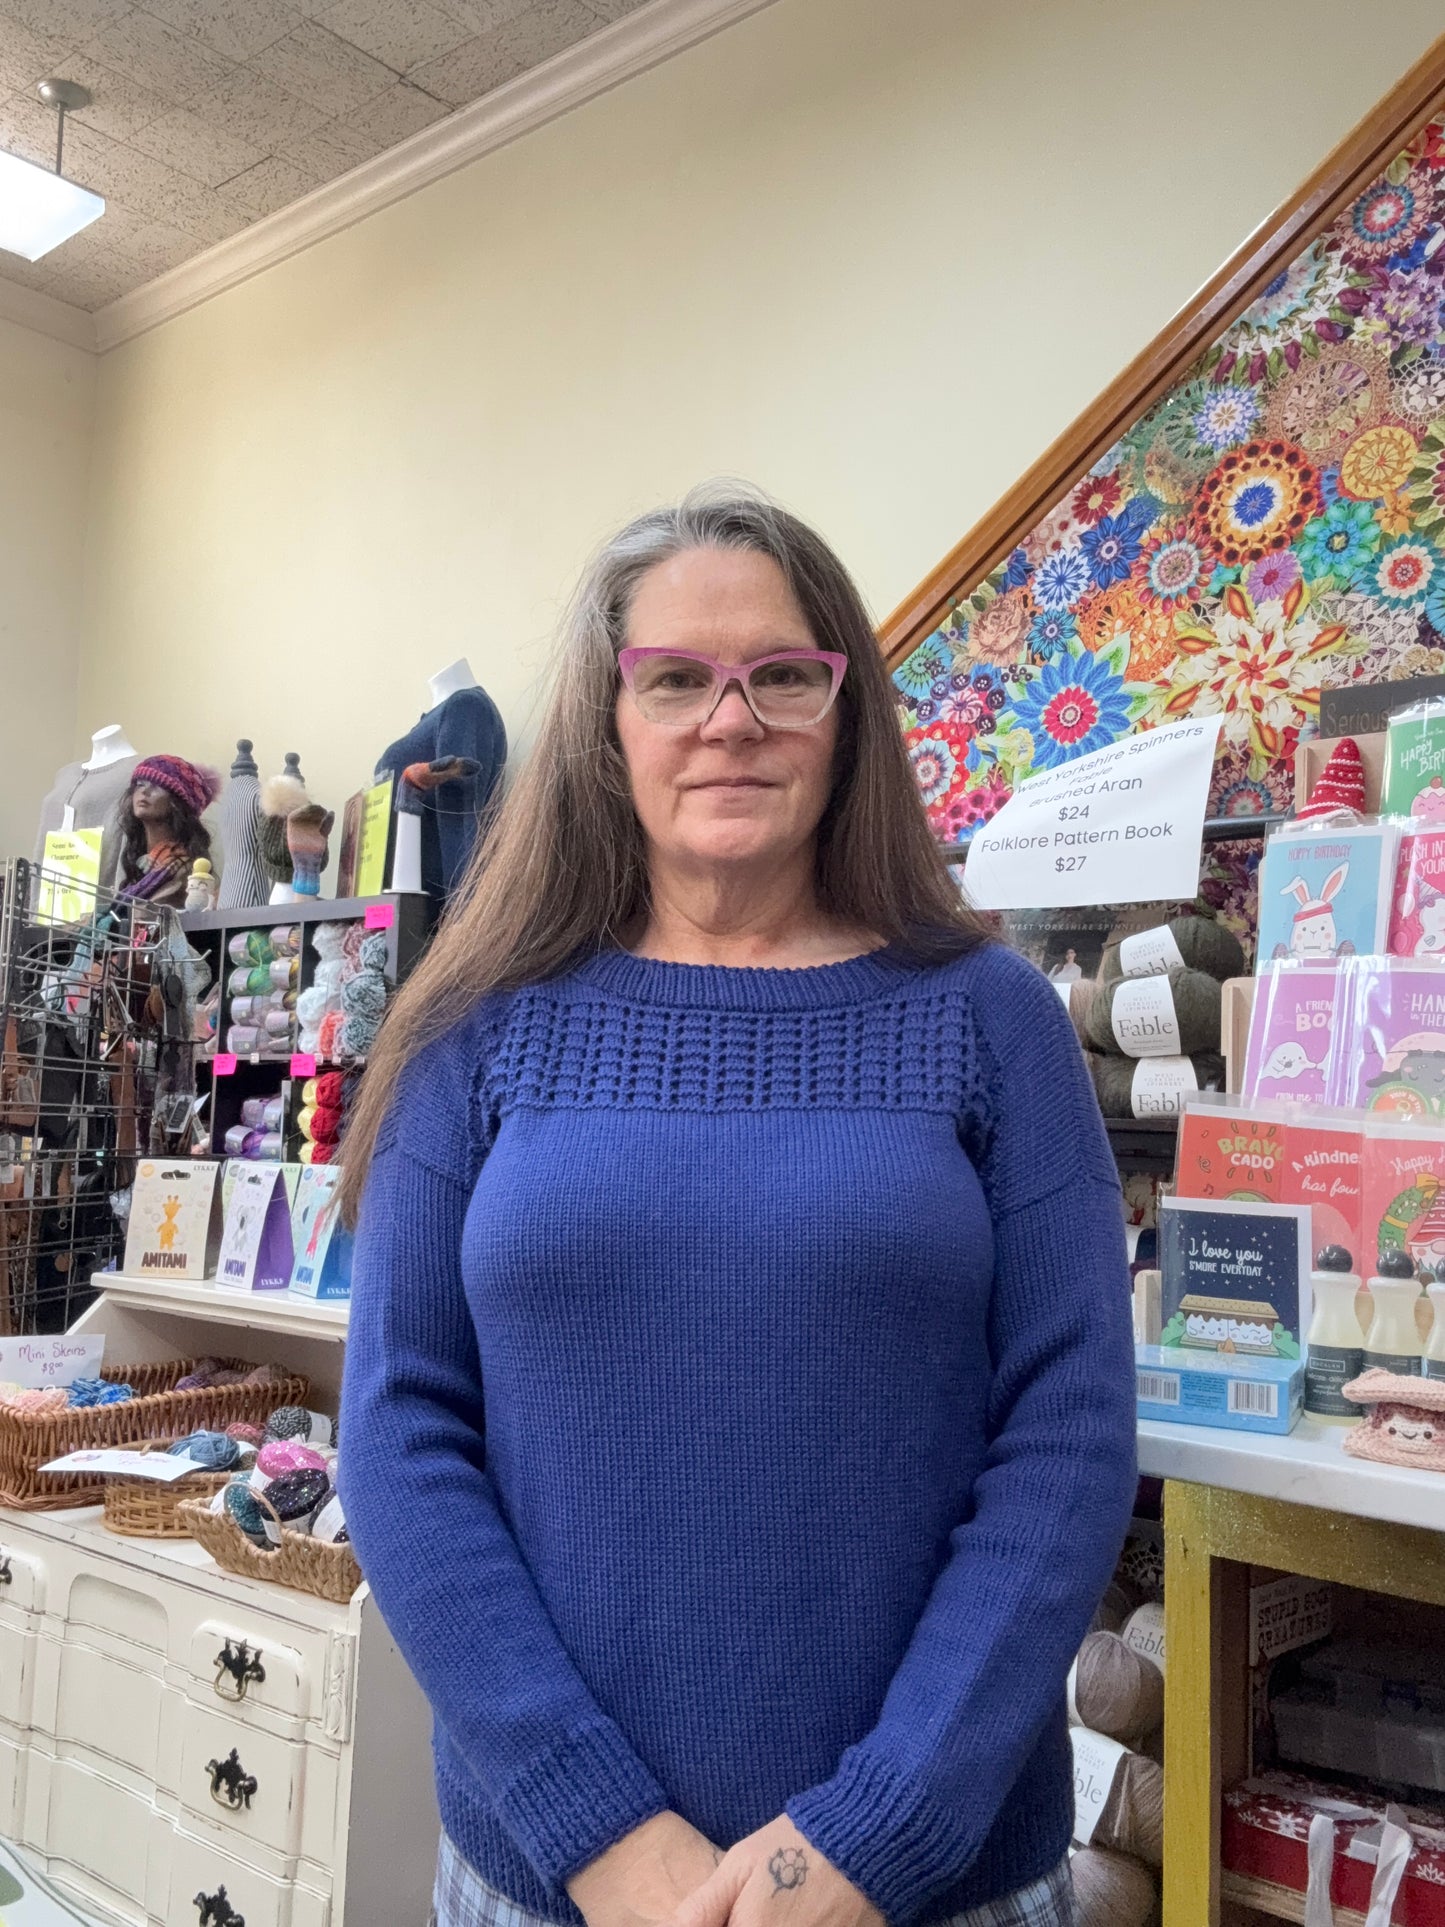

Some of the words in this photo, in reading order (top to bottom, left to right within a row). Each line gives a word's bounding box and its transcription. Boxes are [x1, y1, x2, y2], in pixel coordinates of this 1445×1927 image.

[1326, 702, 1391, 736] Serious
[1017, 777, 1052, 794] West
[1055, 750, 1124, 781] Yorkshire
[1129, 725, 1204, 757] Spinners
[1400, 739, 1433, 771] HAPPY
[1099, 777, 1142, 793] Aran
[1058, 805, 1090, 821] $24
[981, 833, 1049, 853] Folklore
[1054, 829, 1119, 847] Pattern
[1125, 822, 1173, 838] Book
[1055, 856, 1087, 873] $27
[1009, 923, 1034, 931] WEST
[1038, 923, 1094, 931] YORKSHIRE
[1117, 1016, 1174, 1037] Fable
[1137, 1092, 1181, 1112] Fabl
[1230, 1153, 1275, 1170] CADO
[1291, 1161, 1304, 1173] A
[1301, 1174, 1326, 1192] has
[1329, 1177, 1360, 1198] fou
[141, 1252, 188, 1269] AMITAMI
[1188, 1237, 1199, 1256] I
[1202, 1240, 1232, 1259] love
[1236, 1249, 1263, 1266] you
[1189, 1260, 1217, 1273] S'MORE
[1221, 1263, 1263, 1277] EVERYDAY
[19, 1344, 45, 1363] Mini
[52, 1341, 86, 1358] Skeins
[1074, 1766, 1103, 1804] ble
